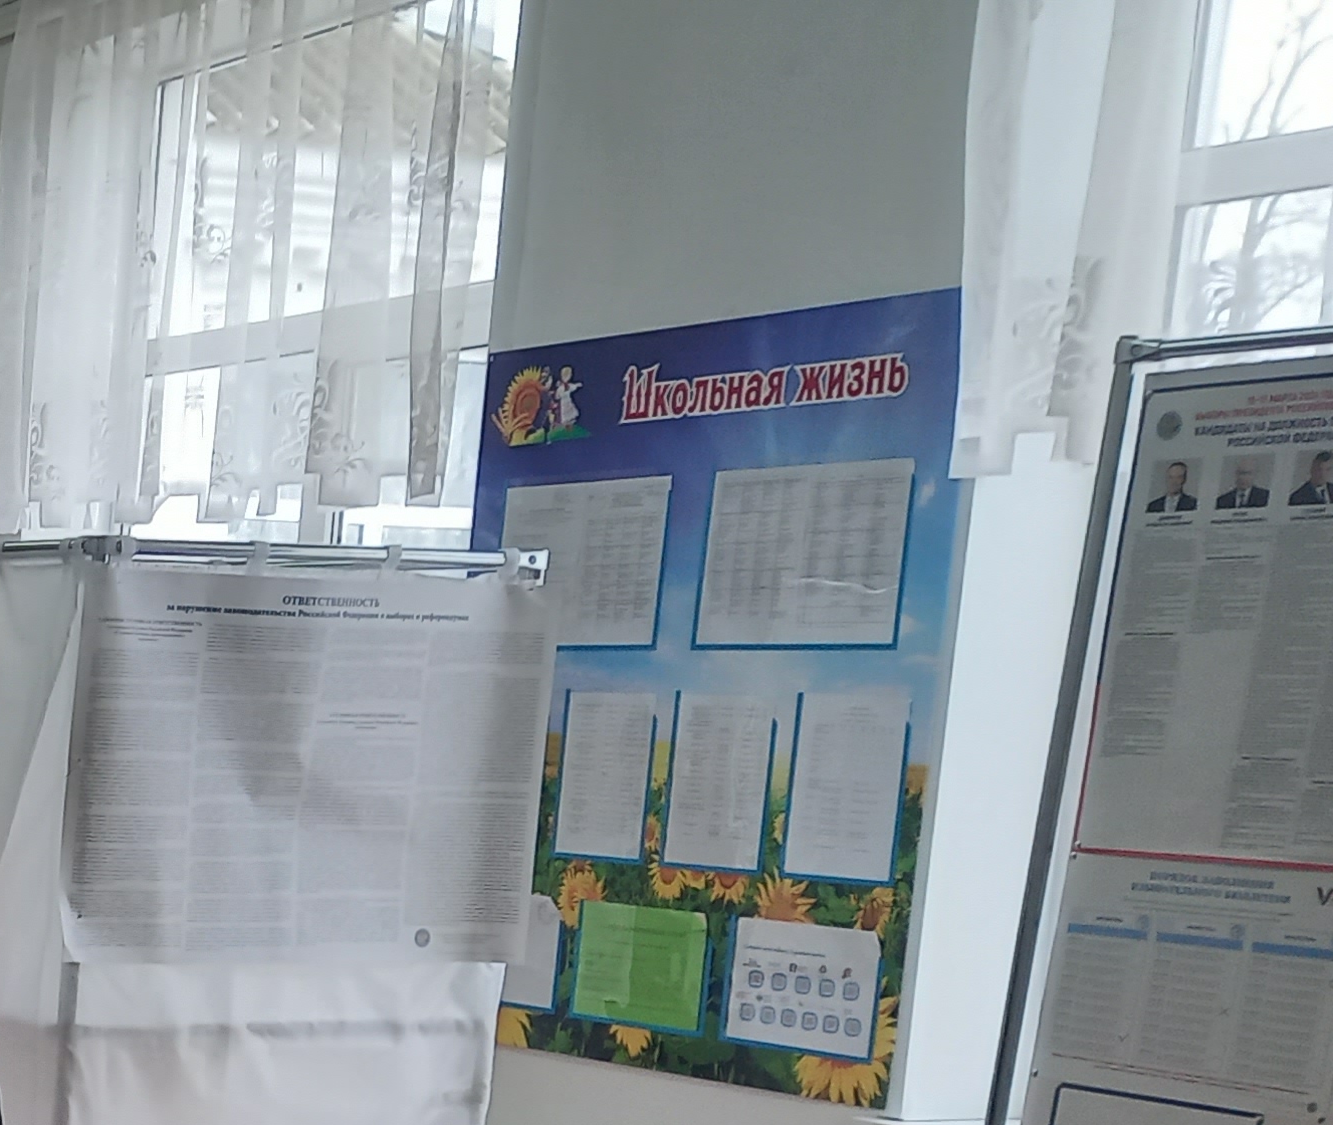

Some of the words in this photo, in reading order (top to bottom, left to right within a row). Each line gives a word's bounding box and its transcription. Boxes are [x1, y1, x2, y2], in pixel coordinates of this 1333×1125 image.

[621, 364, 789, 423] Школьная
[792, 355, 908, 406] жизнь
[282, 595, 380, 608] ОТВЕТСТВЕННОСТЬ
